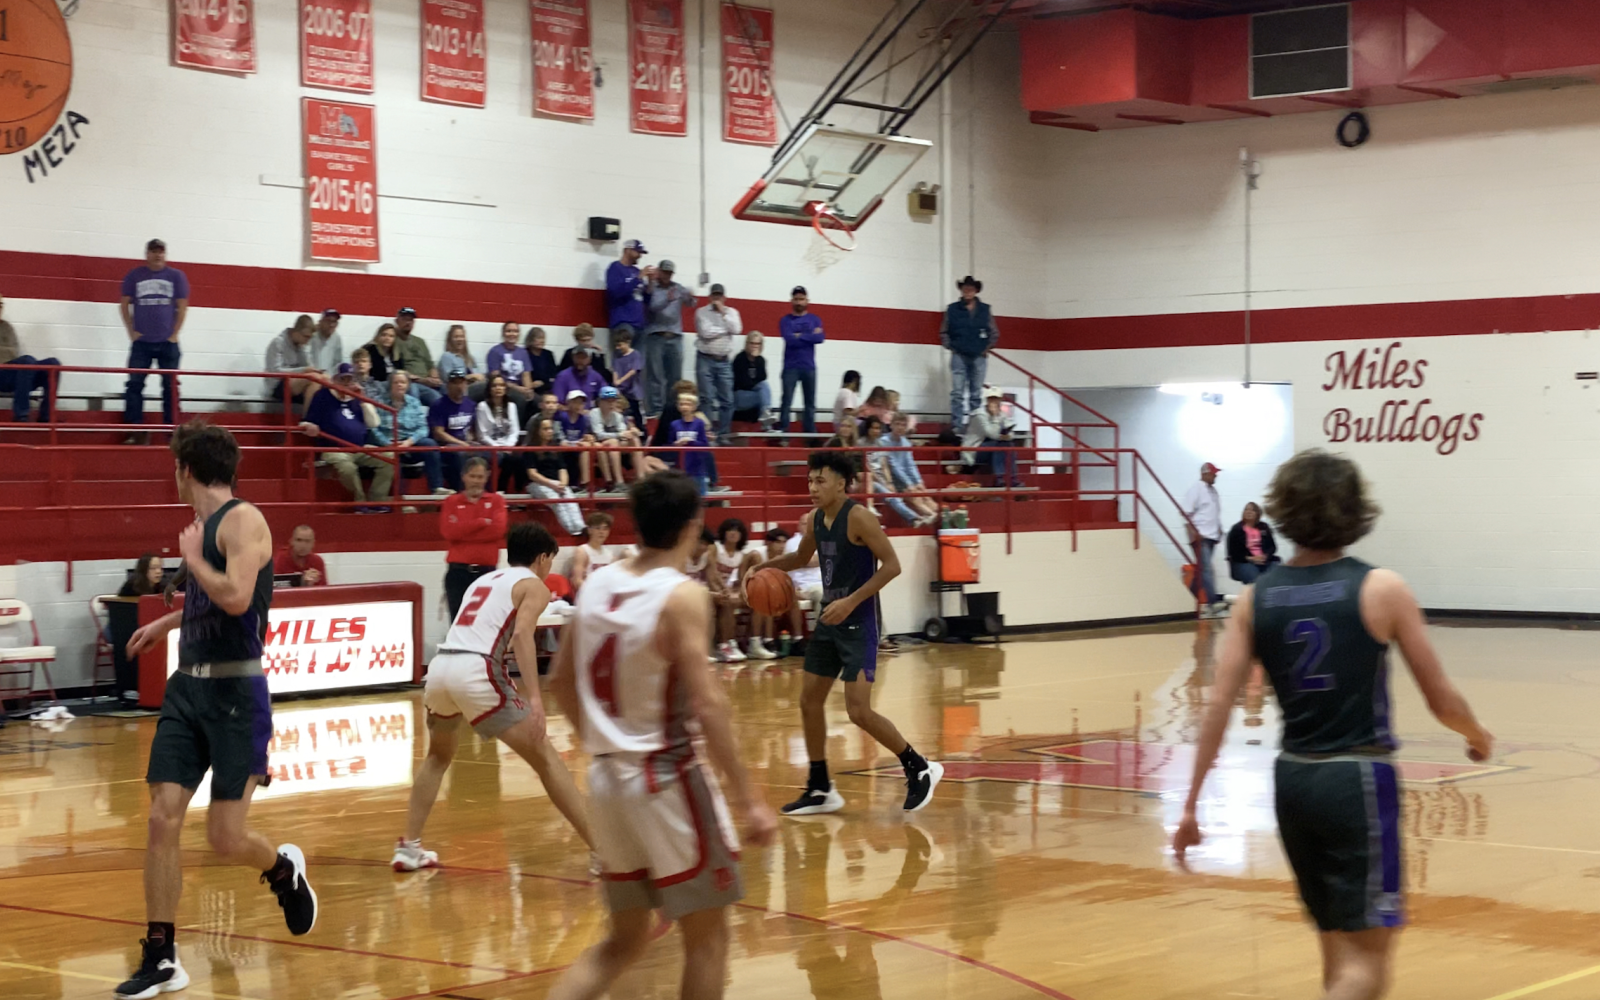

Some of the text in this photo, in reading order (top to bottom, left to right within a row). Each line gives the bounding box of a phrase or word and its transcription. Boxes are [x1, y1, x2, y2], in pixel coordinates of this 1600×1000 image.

[304, 4, 370, 40] 2006-07
[425, 23, 485, 59] 2013-14
[635, 61, 682, 93] 2014
[727, 65, 772, 97] 2015
[23, 111, 90, 184] MEZA
[326, 162, 355, 172] GIRLS
[309, 175, 373, 215] 2015-16
[311, 233, 376, 248] CHAMPIONS
[1322, 341, 1429, 391] Miles
[1323, 398, 1485, 456] Bulldogs
[455, 586, 493, 626] 2
[264, 616, 367, 646] MILES
[1284, 616, 1338, 693] 2
